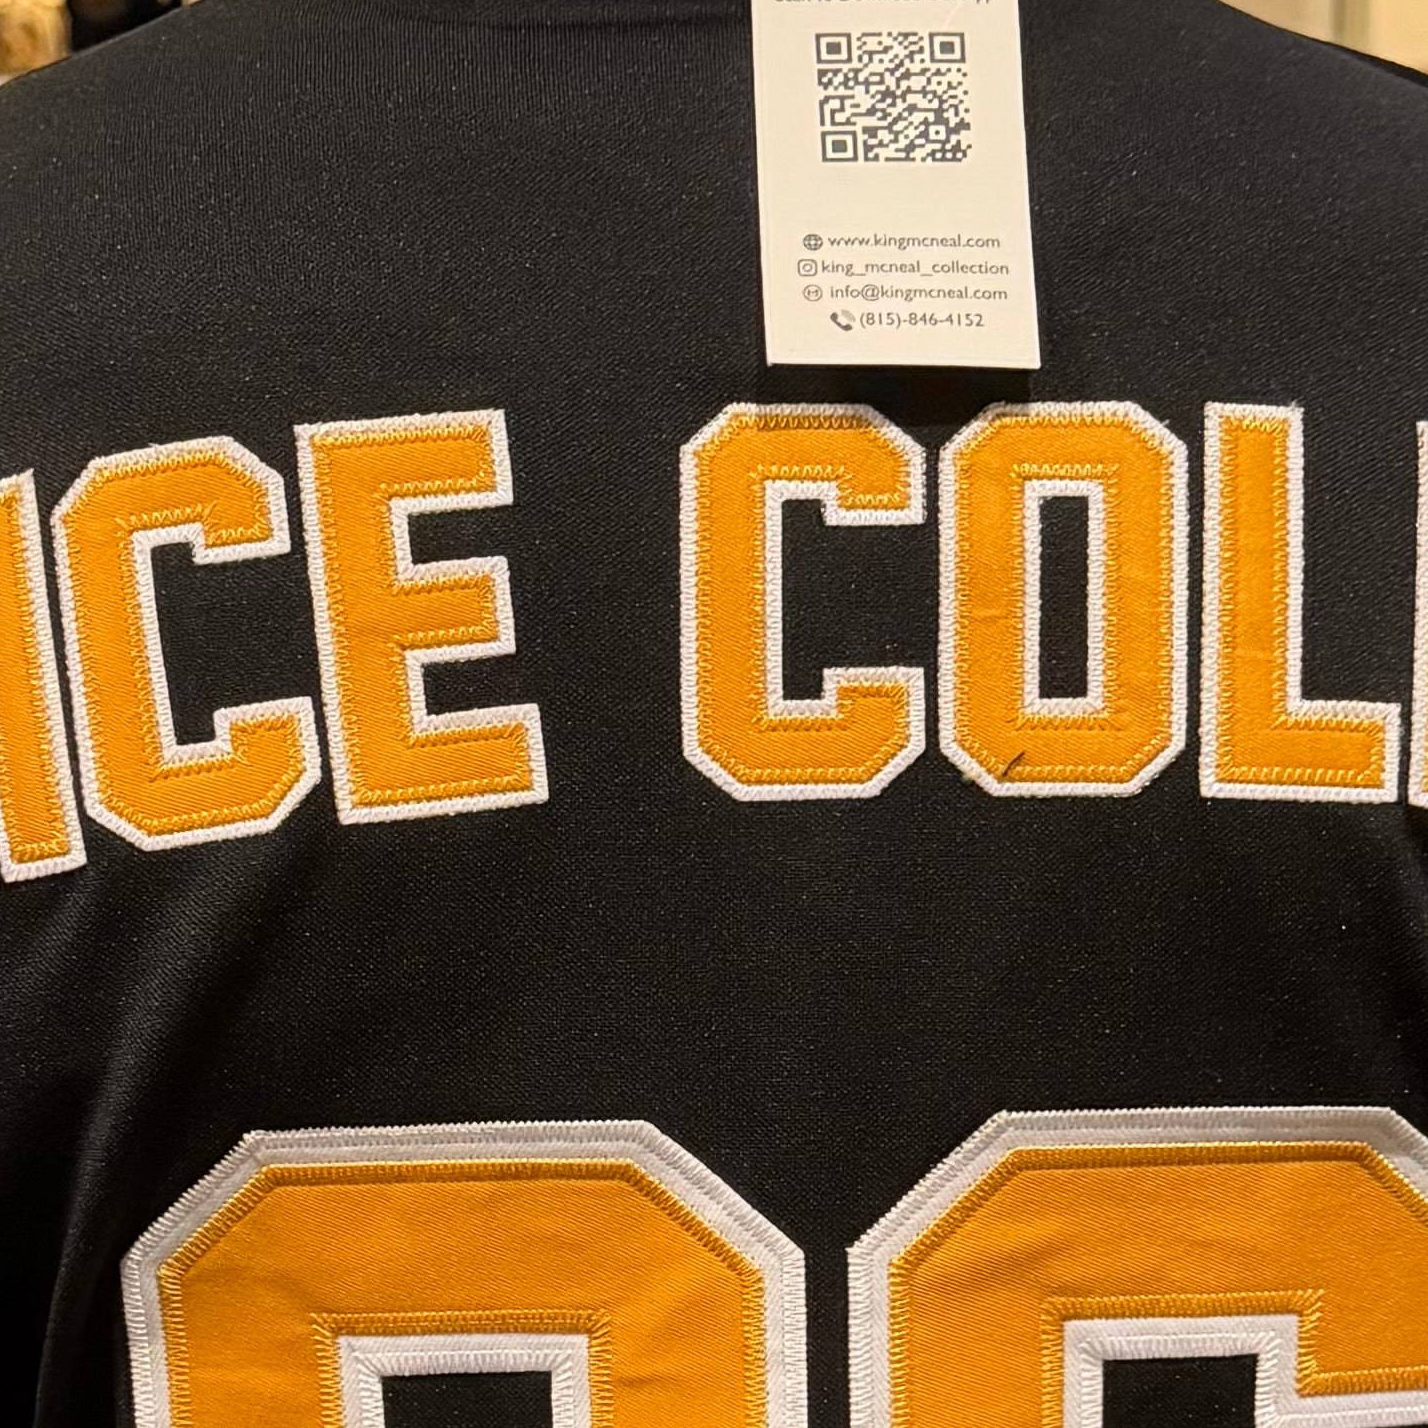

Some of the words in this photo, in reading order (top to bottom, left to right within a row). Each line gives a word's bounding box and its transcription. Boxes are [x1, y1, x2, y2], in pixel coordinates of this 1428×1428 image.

[828, 233, 1001, 251] www.kingmcneal.com
[821, 259, 1010, 277] king_mcneal_collection
[830, 283, 1008, 302] info@kingmcneal.com
[859, 312, 985, 329] (815)-846-4152
